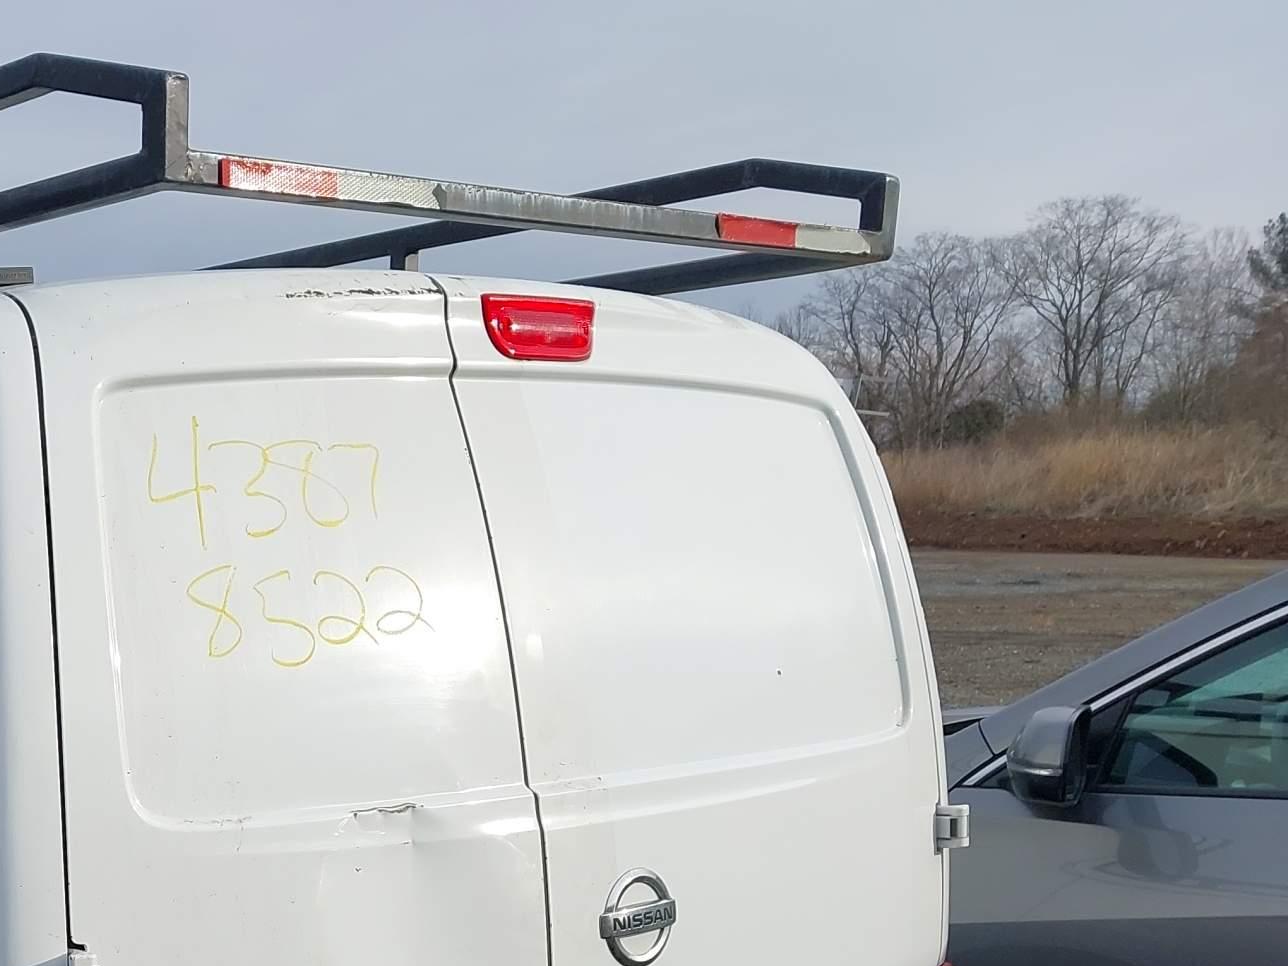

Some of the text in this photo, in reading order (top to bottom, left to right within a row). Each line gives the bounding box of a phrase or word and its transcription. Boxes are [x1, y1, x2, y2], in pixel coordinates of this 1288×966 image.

[148, 415, 379, 550] 4387
[186, 565, 436, 667] 8522
[612, 905, 673, 931] NISSAN
